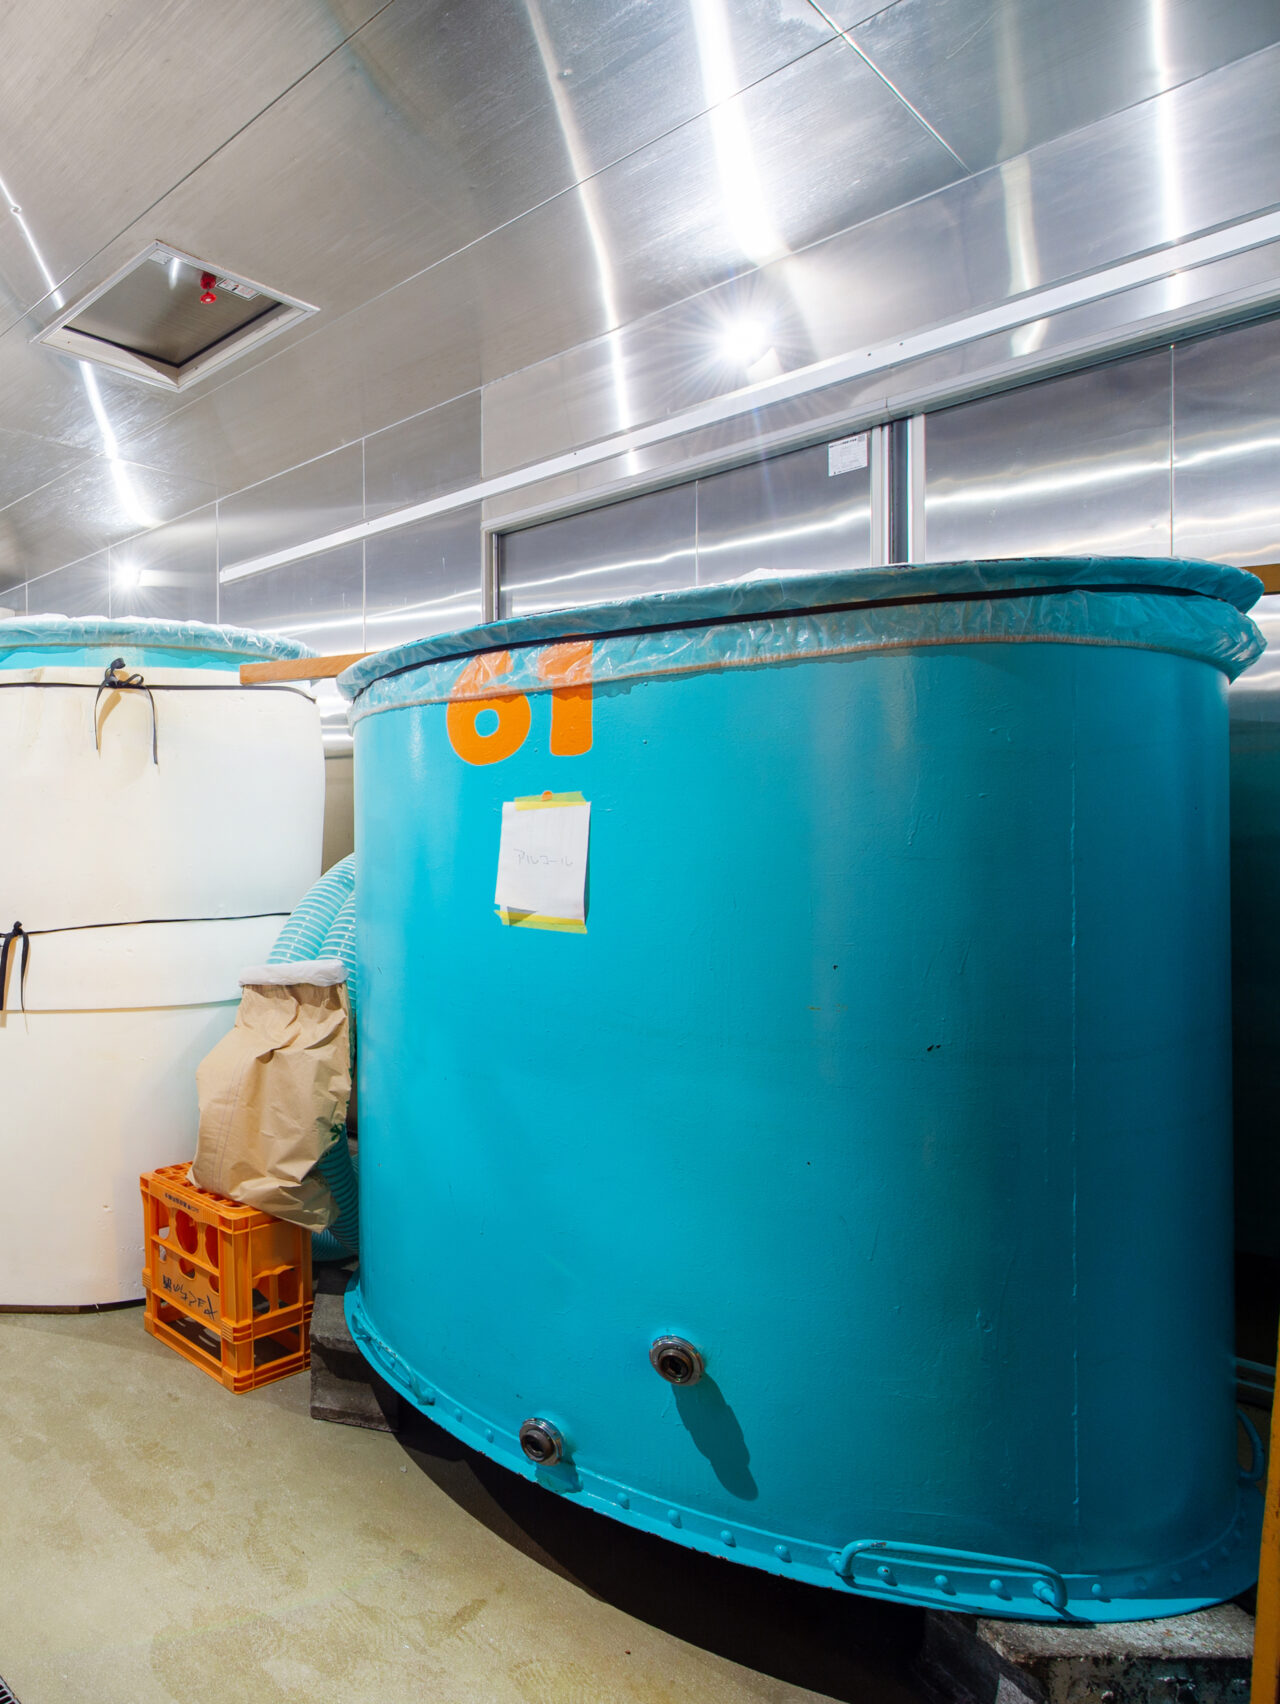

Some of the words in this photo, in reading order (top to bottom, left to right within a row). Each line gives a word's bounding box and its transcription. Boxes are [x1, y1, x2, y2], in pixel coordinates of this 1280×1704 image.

[446, 633, 593, 766] 61
[513, 848, 573, 867] アルコール
